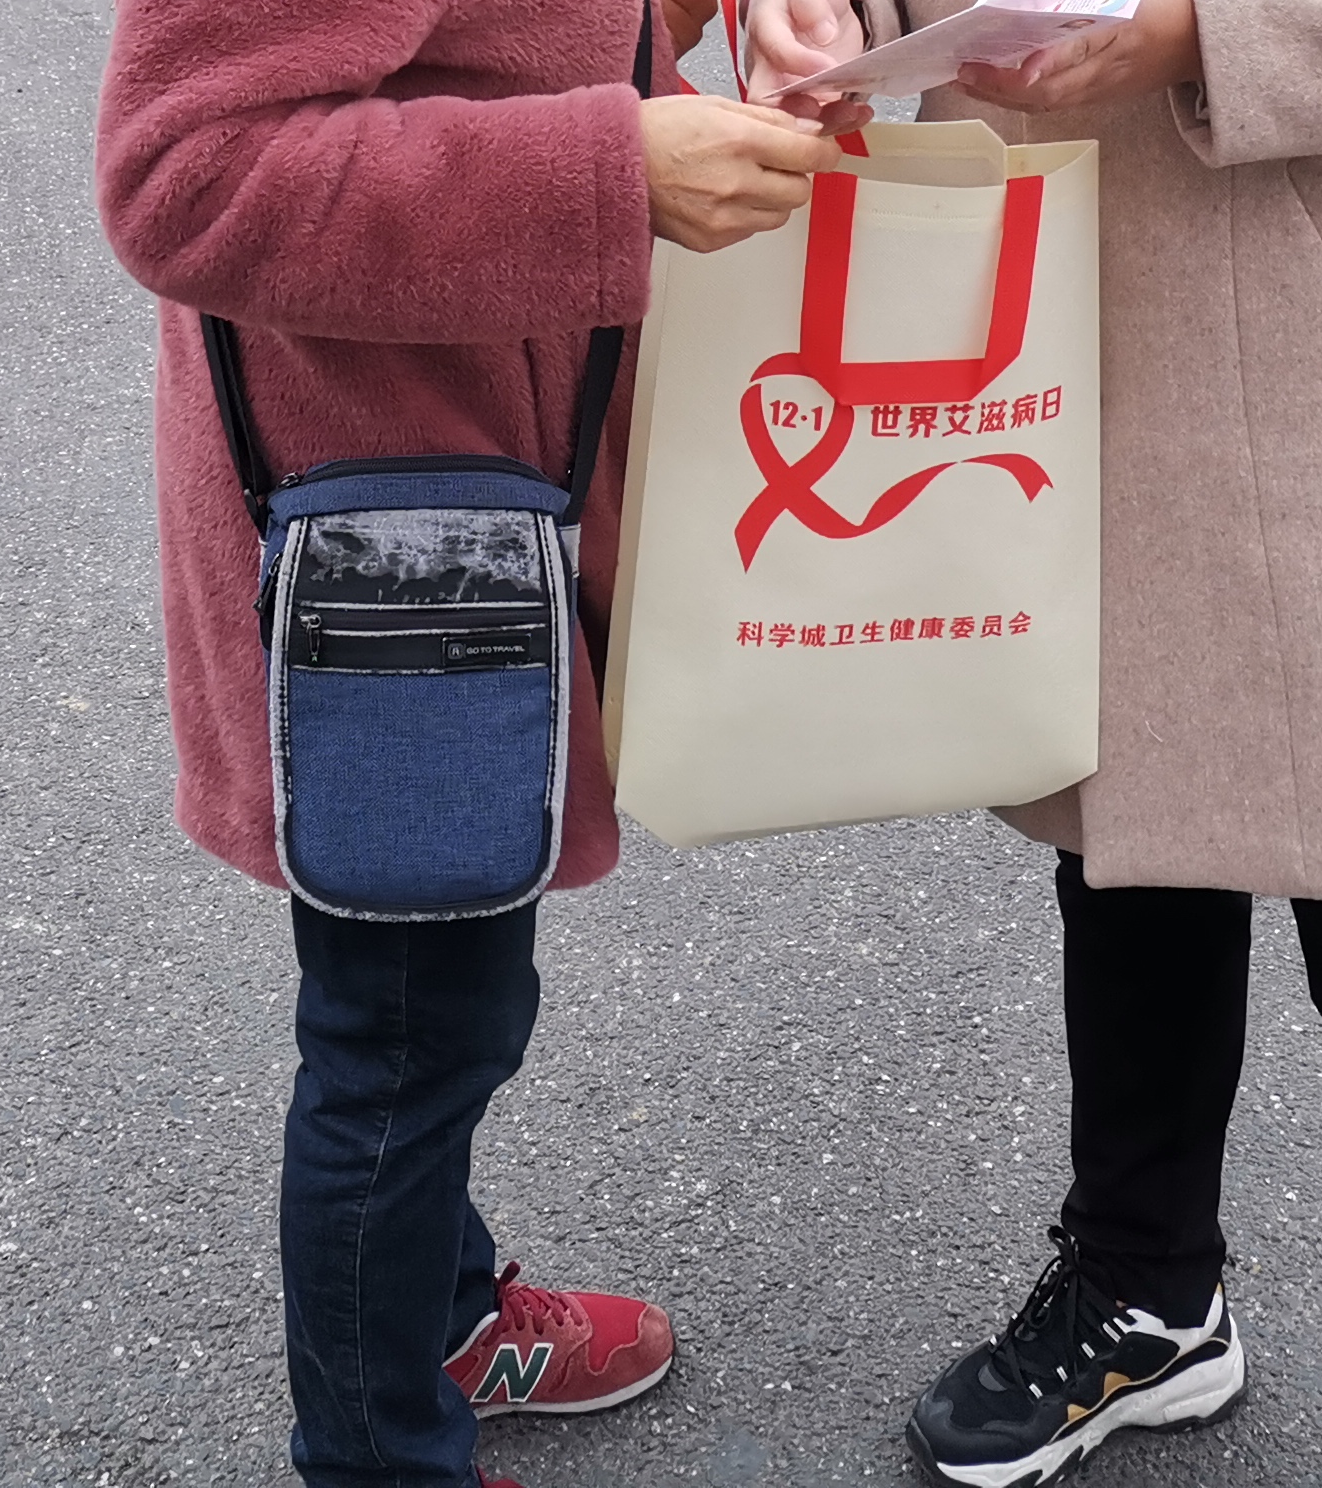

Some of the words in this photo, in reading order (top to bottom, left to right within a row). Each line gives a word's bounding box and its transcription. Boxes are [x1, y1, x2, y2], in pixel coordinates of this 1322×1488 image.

[870, 384, 1063, 439] 世界艾滋病日
[481, 646, 492, 654] TO
[493, 645, 525, 653] TRAVEL
[736, 610, 1032, 649] 科学城卫生健康委员会
[469, 1342, 554, 1403] N
